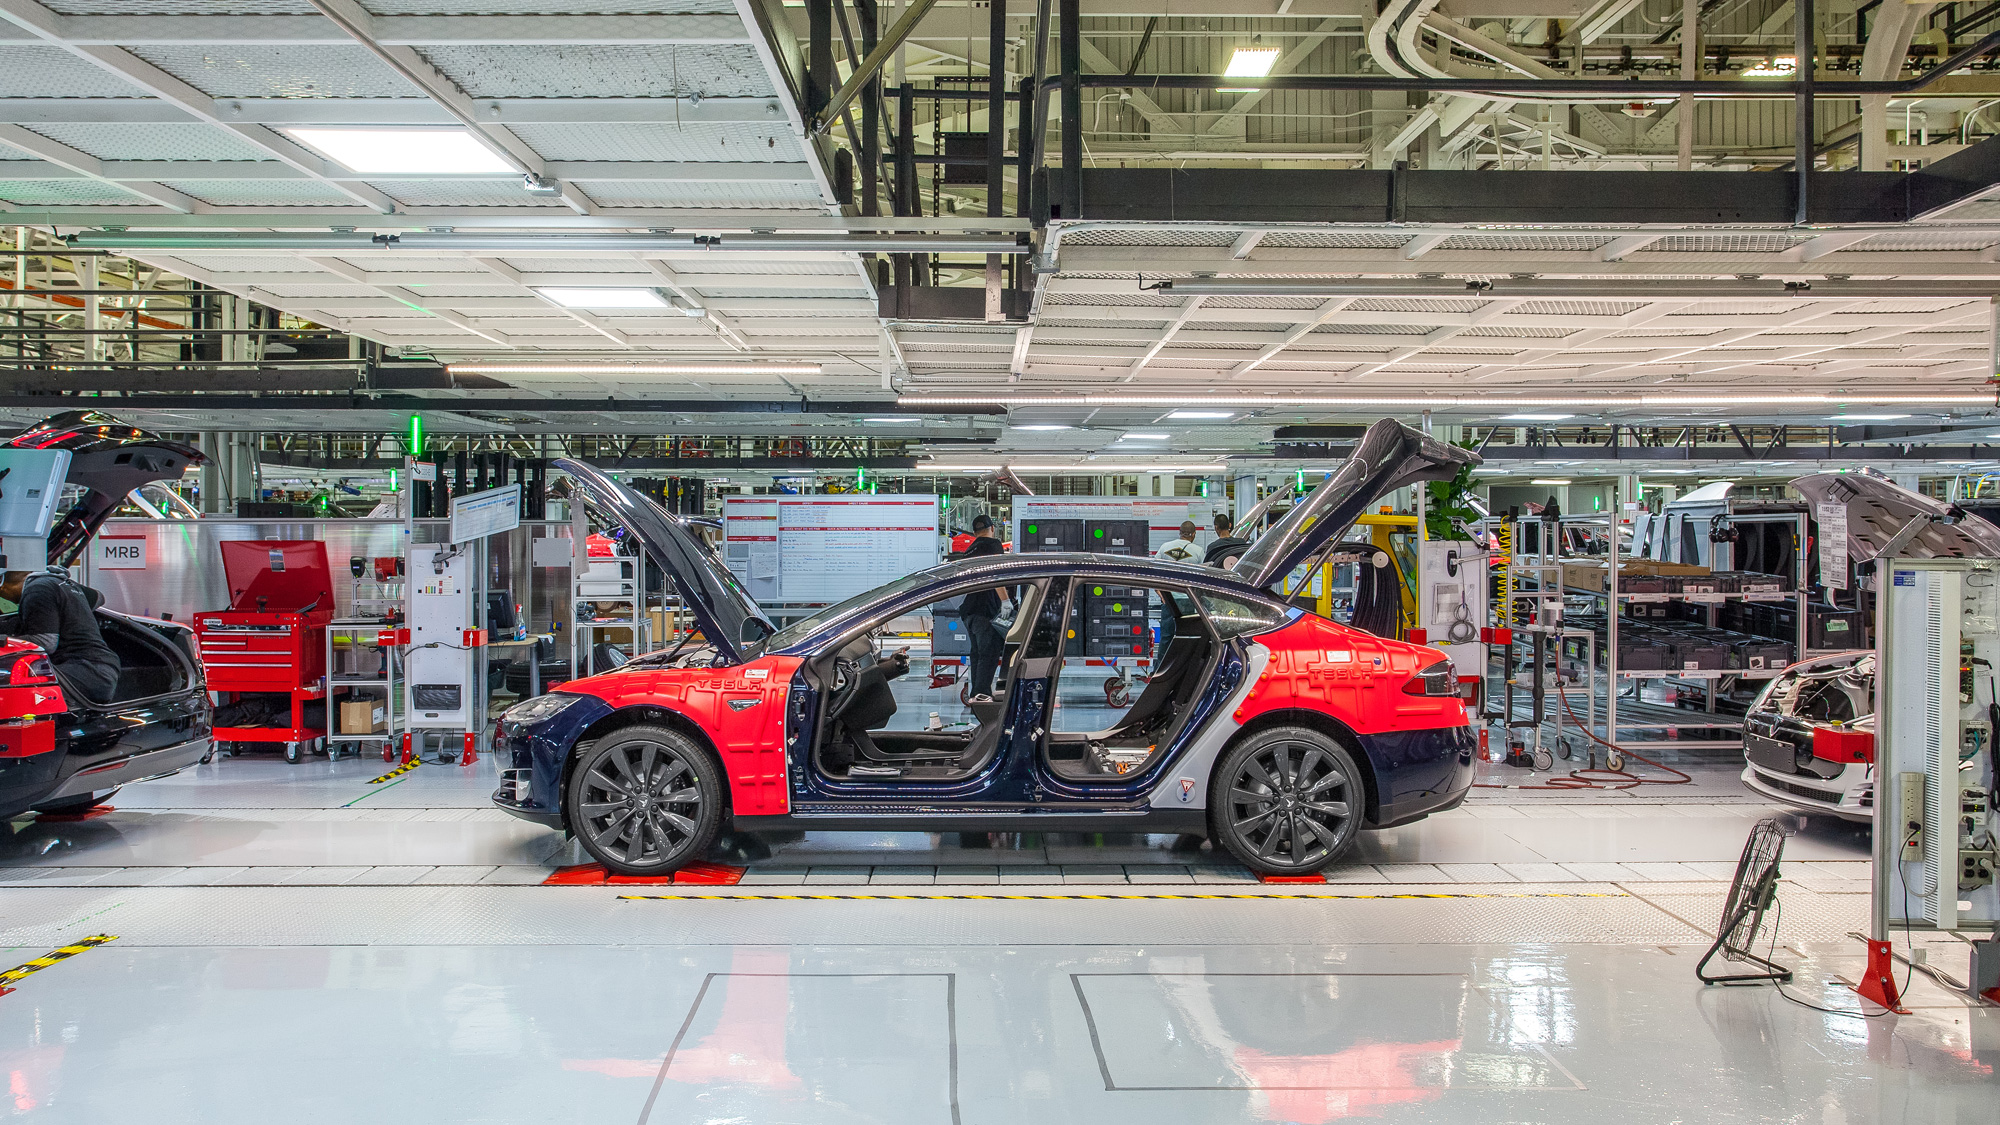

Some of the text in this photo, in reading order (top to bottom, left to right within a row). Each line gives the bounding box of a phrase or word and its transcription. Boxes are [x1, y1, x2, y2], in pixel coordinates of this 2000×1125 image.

[105, 546, 140, 558] MRB
[1309, 668, 1373, 680] TESLA
[698, 679, 762, 690] TESLA
